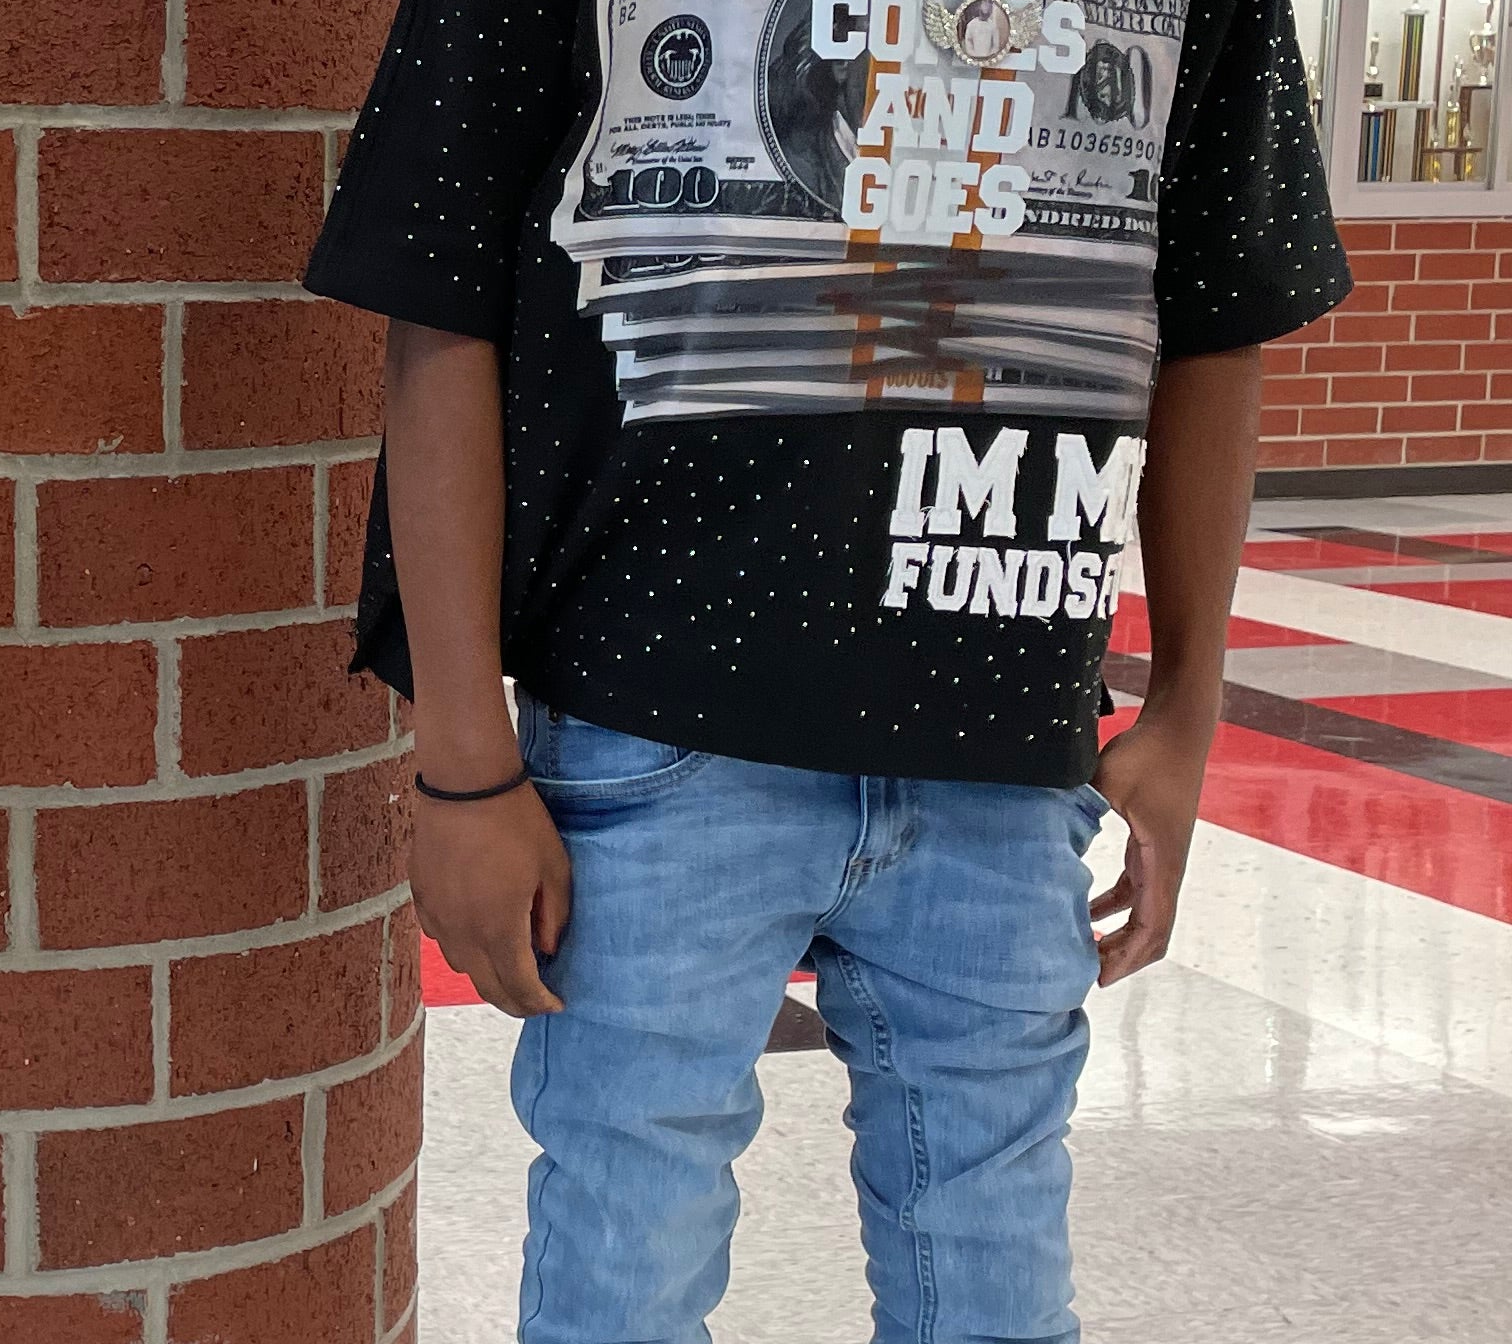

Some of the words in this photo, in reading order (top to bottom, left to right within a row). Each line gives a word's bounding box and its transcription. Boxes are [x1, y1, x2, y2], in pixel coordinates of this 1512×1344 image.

[857, 72, 1035, 154] AND
[604, 165, 720, 211] 100
[840, 157, 1031, 236] GOES
[889, 426, 1029, 539] IM
[884, 541, 1103, 620] FUNDS
